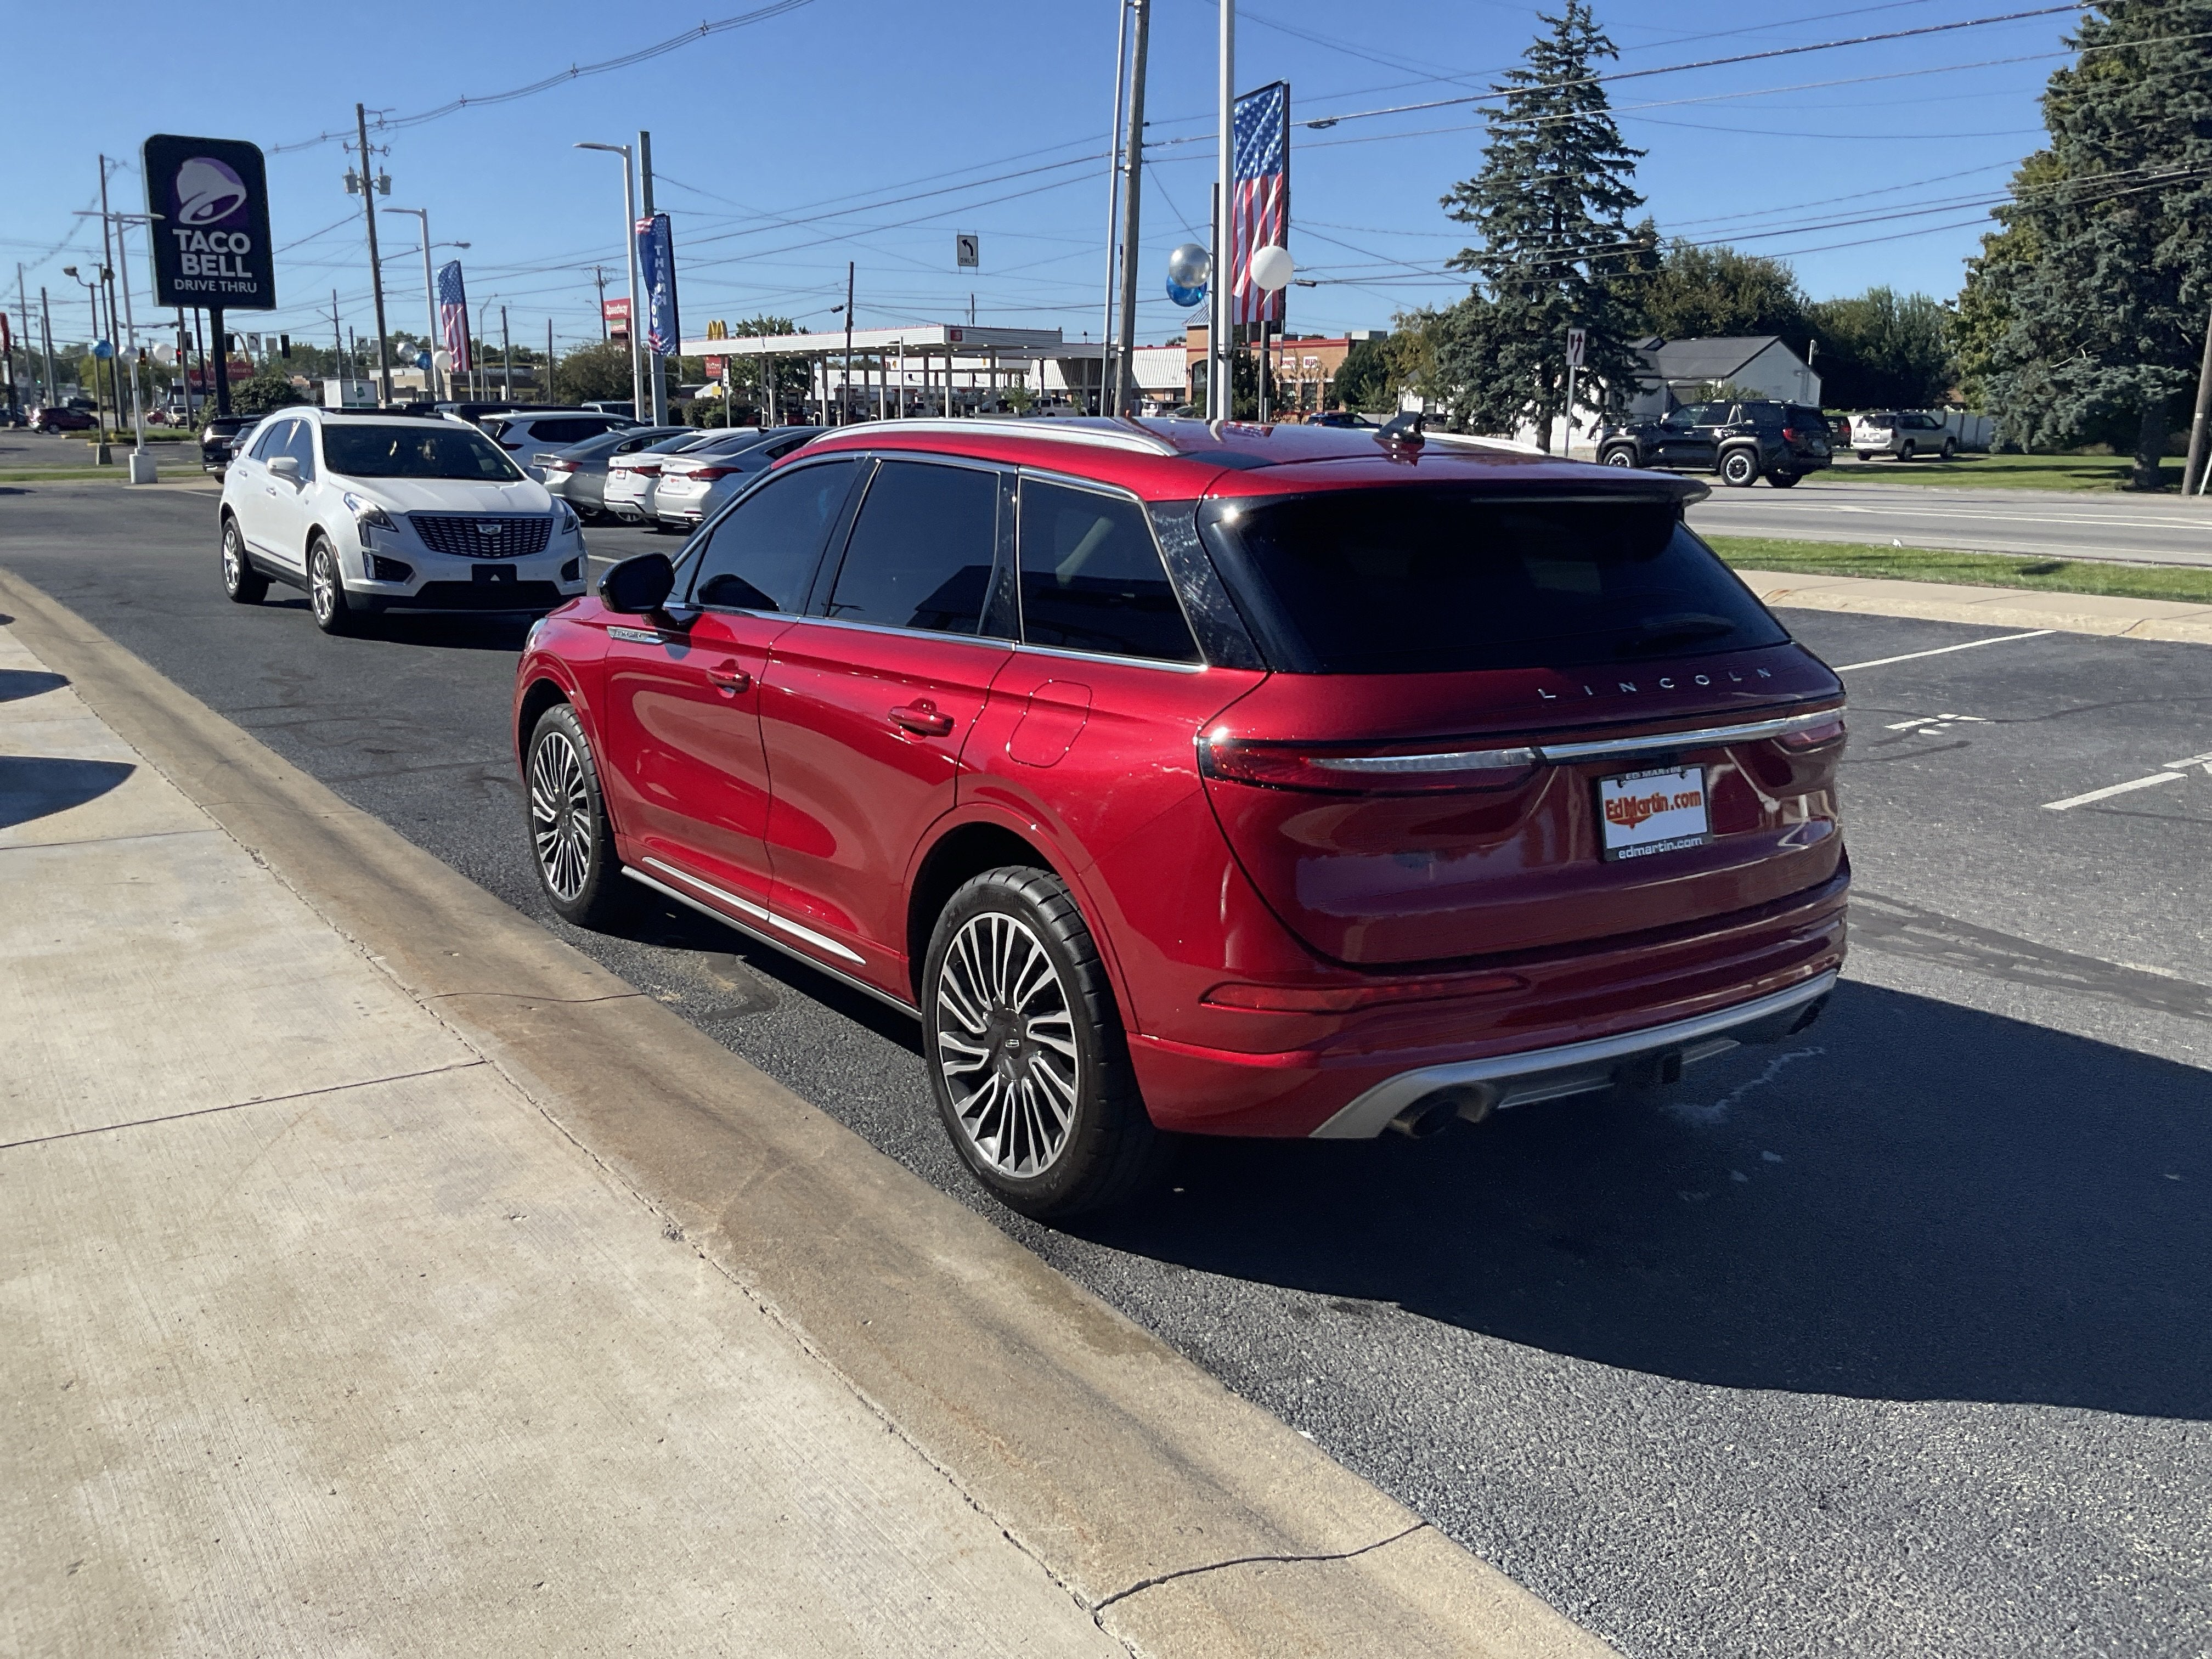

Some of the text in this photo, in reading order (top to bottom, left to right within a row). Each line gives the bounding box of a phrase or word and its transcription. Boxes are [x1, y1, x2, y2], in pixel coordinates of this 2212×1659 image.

[172, 229, 251, 255] TACO
[181, 253, 252, 278] BELL
[174, 279, 257, 293] DRIVE THRU
[1538, 668, 1771, 698] LINCOLN
[1605, 791, 1702, 820] EdMartin.com
[1618, 837, 1703, 859] edmartin.com
